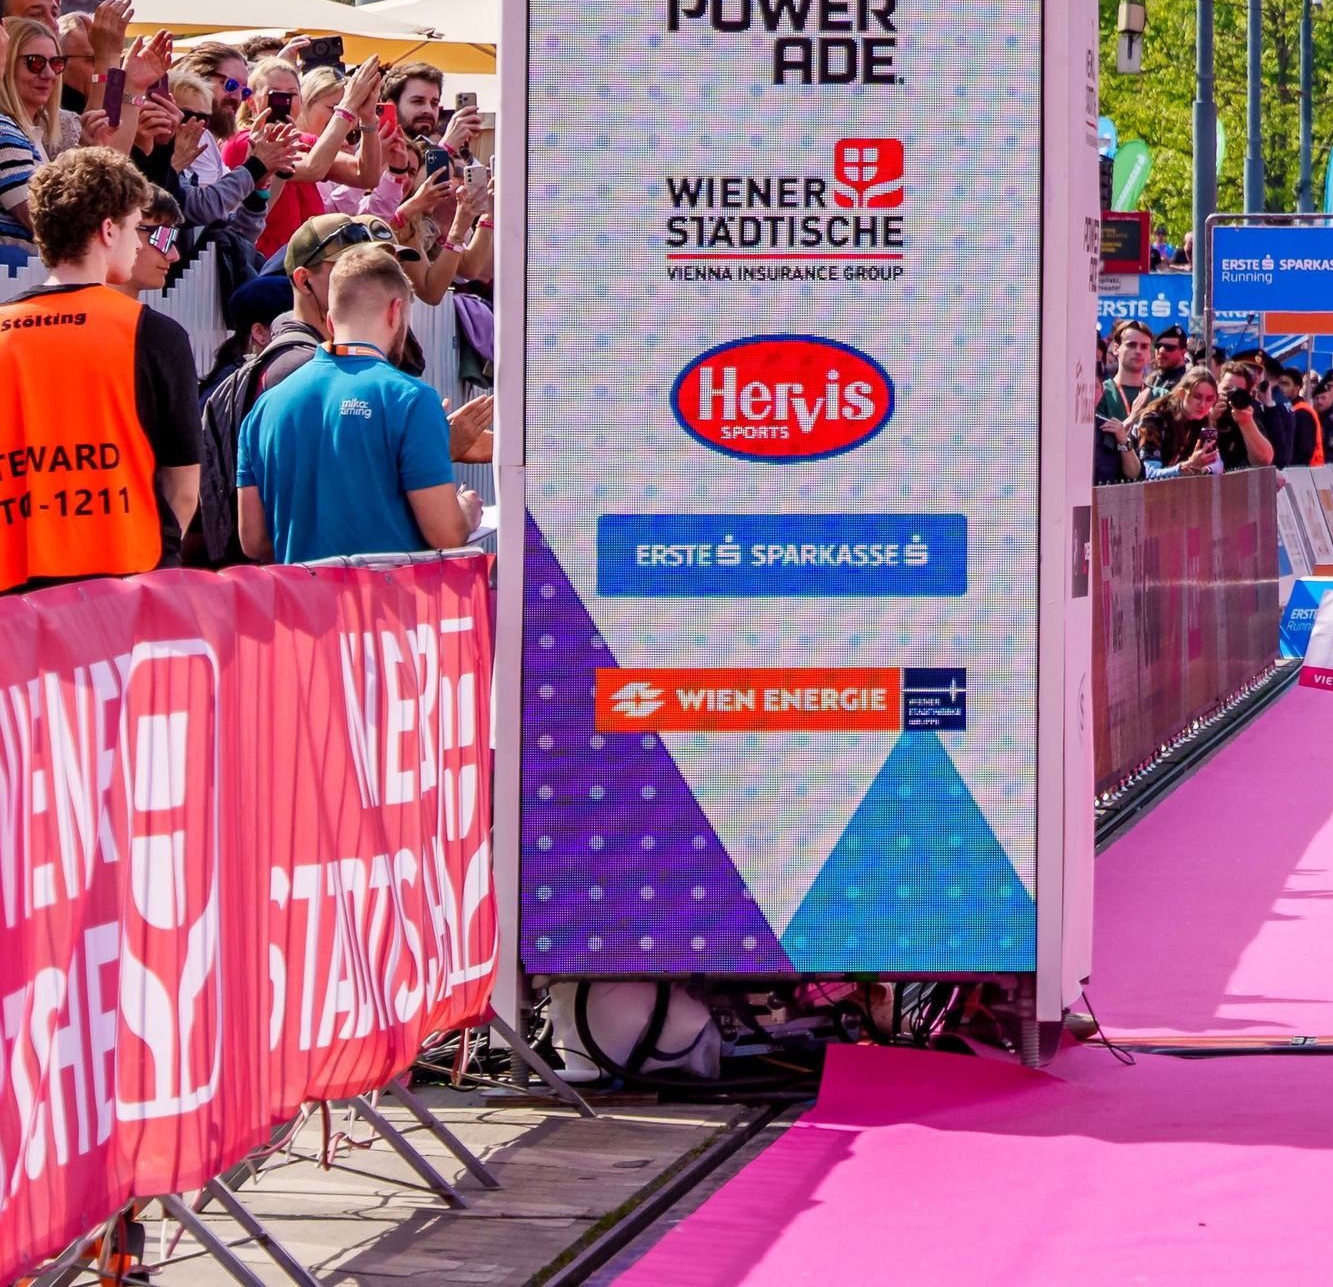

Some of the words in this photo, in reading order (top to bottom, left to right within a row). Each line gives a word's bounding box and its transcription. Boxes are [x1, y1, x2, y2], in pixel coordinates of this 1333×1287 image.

[665, 177, 827, 209] WIENER
[665, 215, 905, 248] STÄDTISCHE
[667, 265, 733, 282] VIENNA
[738, 265, 838, 282] INSURANCE
[842, 265, 904, 282] GROUP
[1221, 258, 1260, 271] ERSTE
[1221, 271, 1273, 285] Running
[1, 312, 87, 332] Stölting
[699, 366, 876, 434] Hervis
[720, 425, 790, 440] SPORTS
[636, 544, 712, 567] ERSTE
[750, 544, 899, 567] SPARKASSE
[1290, 608, 1316, 620] ERST
[675, 687, 756, 713] WIEN
[763, 687, 887, 713] ENERGIE
